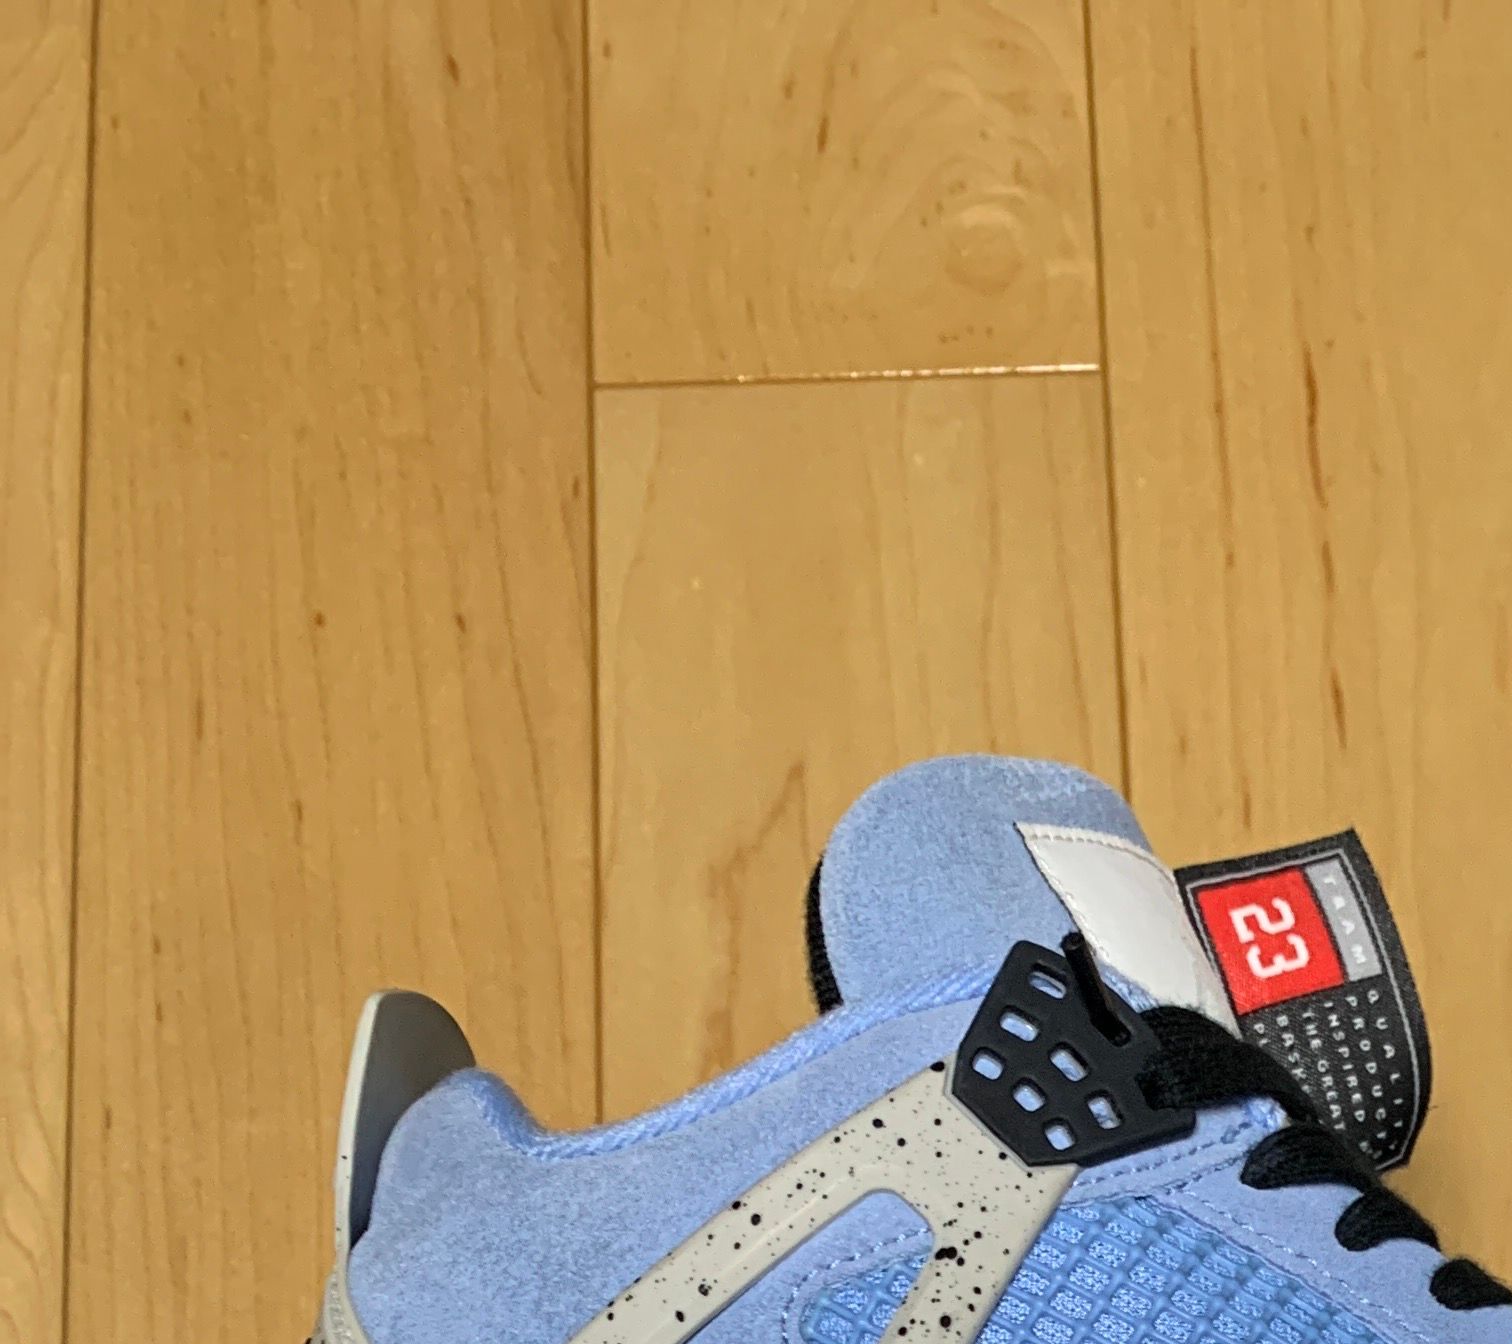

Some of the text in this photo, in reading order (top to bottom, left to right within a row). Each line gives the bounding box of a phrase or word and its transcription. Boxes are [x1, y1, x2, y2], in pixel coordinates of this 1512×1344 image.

[1228, 896, 1311, 980] 23
[1302, 1008, 1323, 1051] THE
[1323, 1001, 1366, 1123] INSPIRED
